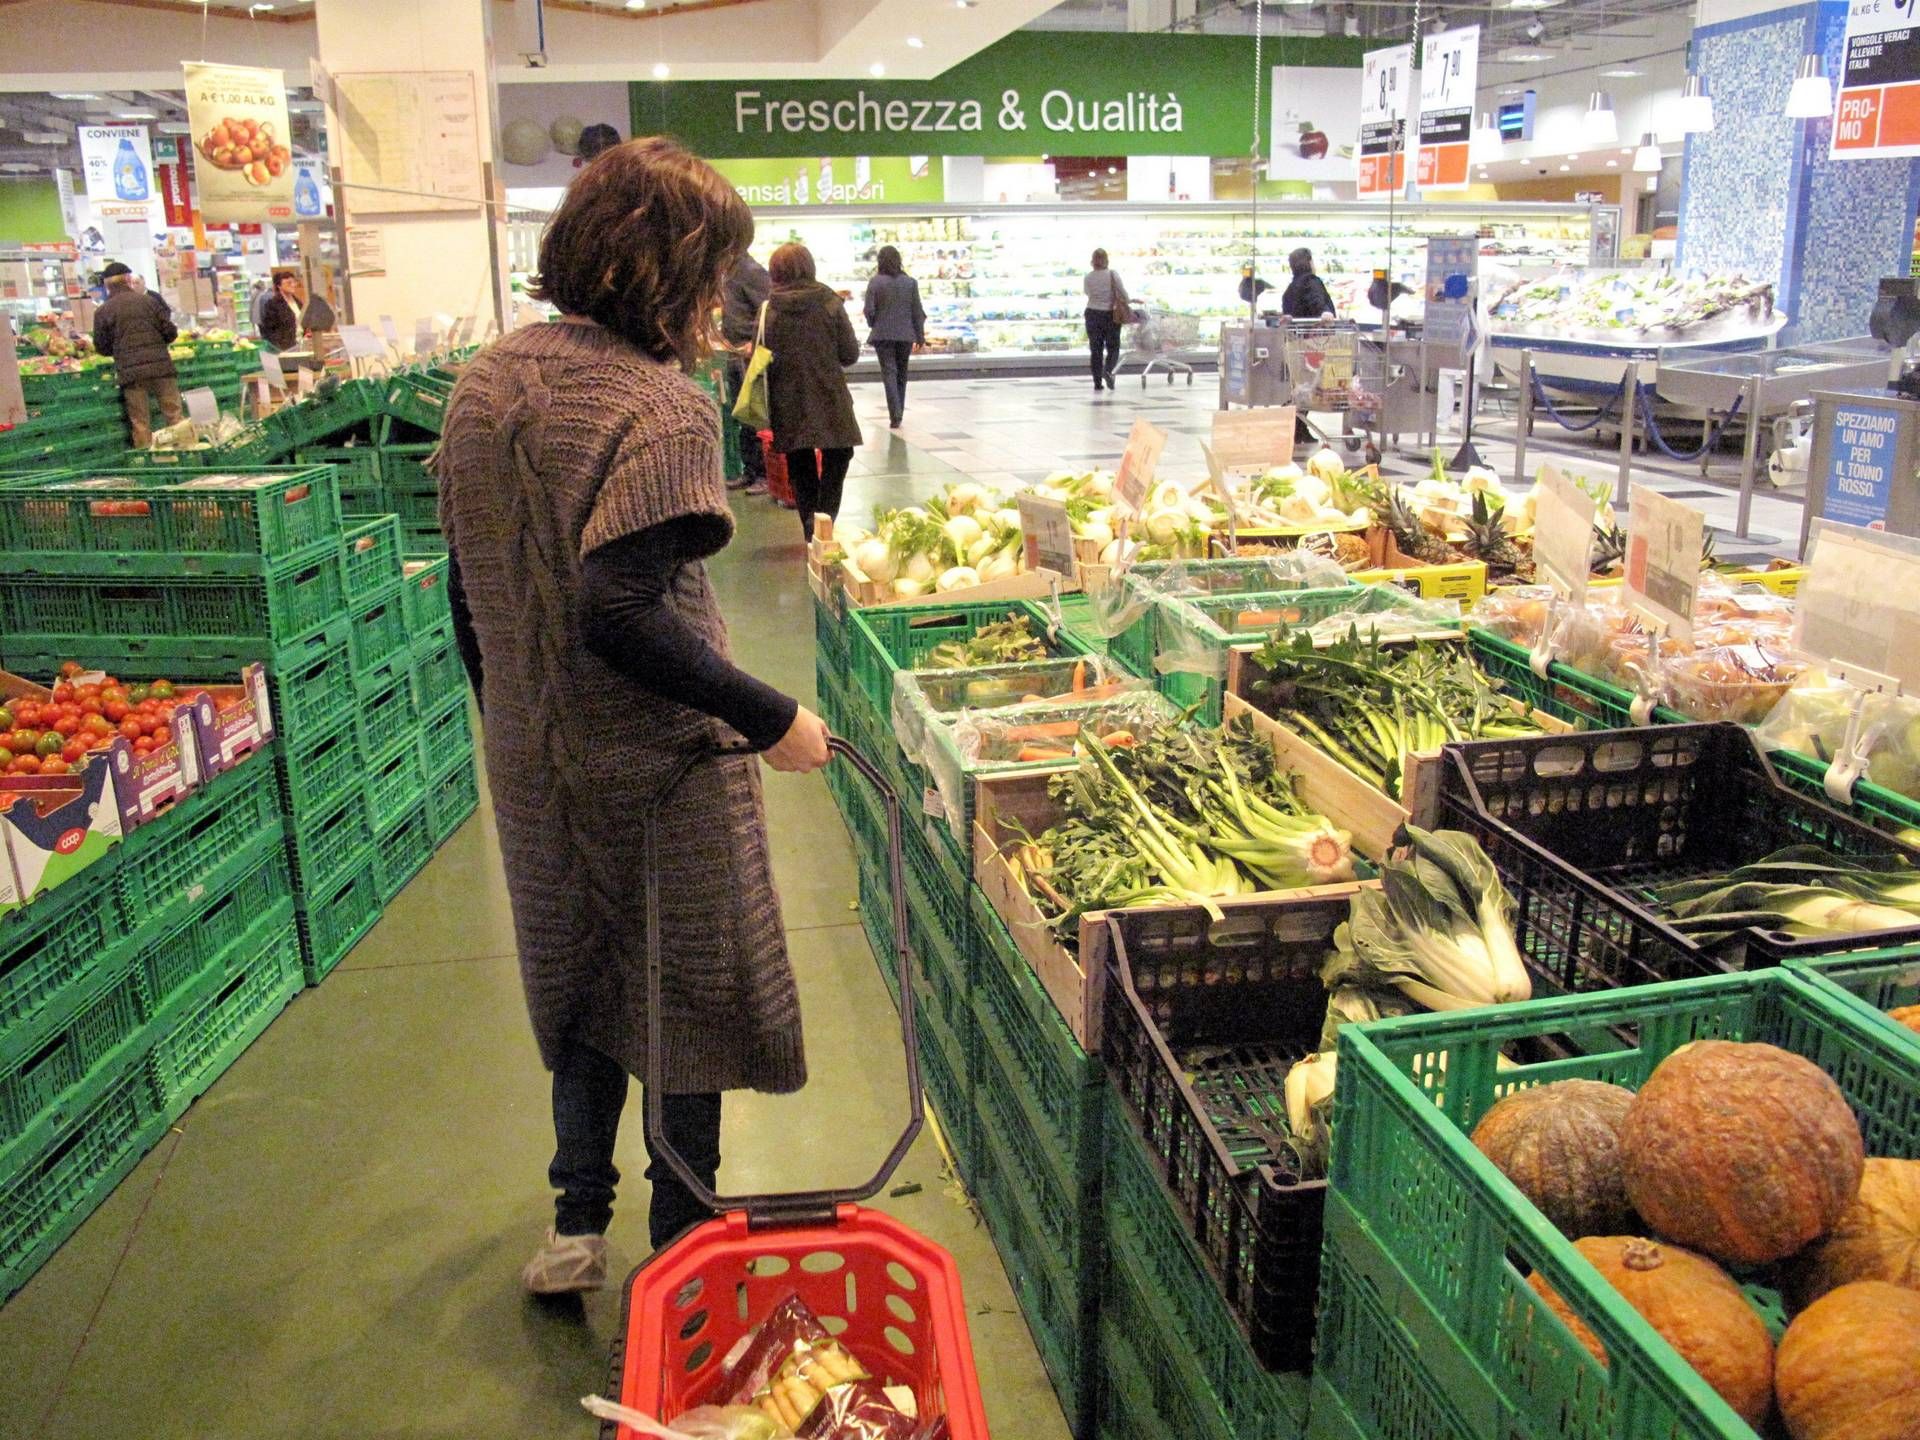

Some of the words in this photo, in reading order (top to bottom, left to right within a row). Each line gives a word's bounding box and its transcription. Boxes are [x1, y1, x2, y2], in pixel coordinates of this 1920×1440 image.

[1851, 33, 1884, 48] VONGOLE
[1884, 29, 1910, 43] VERACI
[1849, 45, 1883, 59] ALLEVATE
[1848, 58, 1870, 70] ITALIA
[735, 91, 982, 133] Freschezza
[998, 89, 1027, 131] &
[1041, 90, 1183, 133] Qualità
[1841, 98, 1876, 120] PRO-
[87, 128, 140, 139] CONVIENE
[1839, 121, 1862, 141] MO
[736, 186, 785, 201] ensa
[1836, 411, 1896, 433] SPEZZIAMO
[1842, 428, 1857, 444] UN
[1858, 432, 1884, 449] AMO
[1850, 447, 1872, 464] PER
[1835, 460, 1845, 476] IL
[1847, 462, 1883, 482] TONNO
[1838, 477, 1875, 498] ROSSO.
[61, 832, 80, 849] coop
